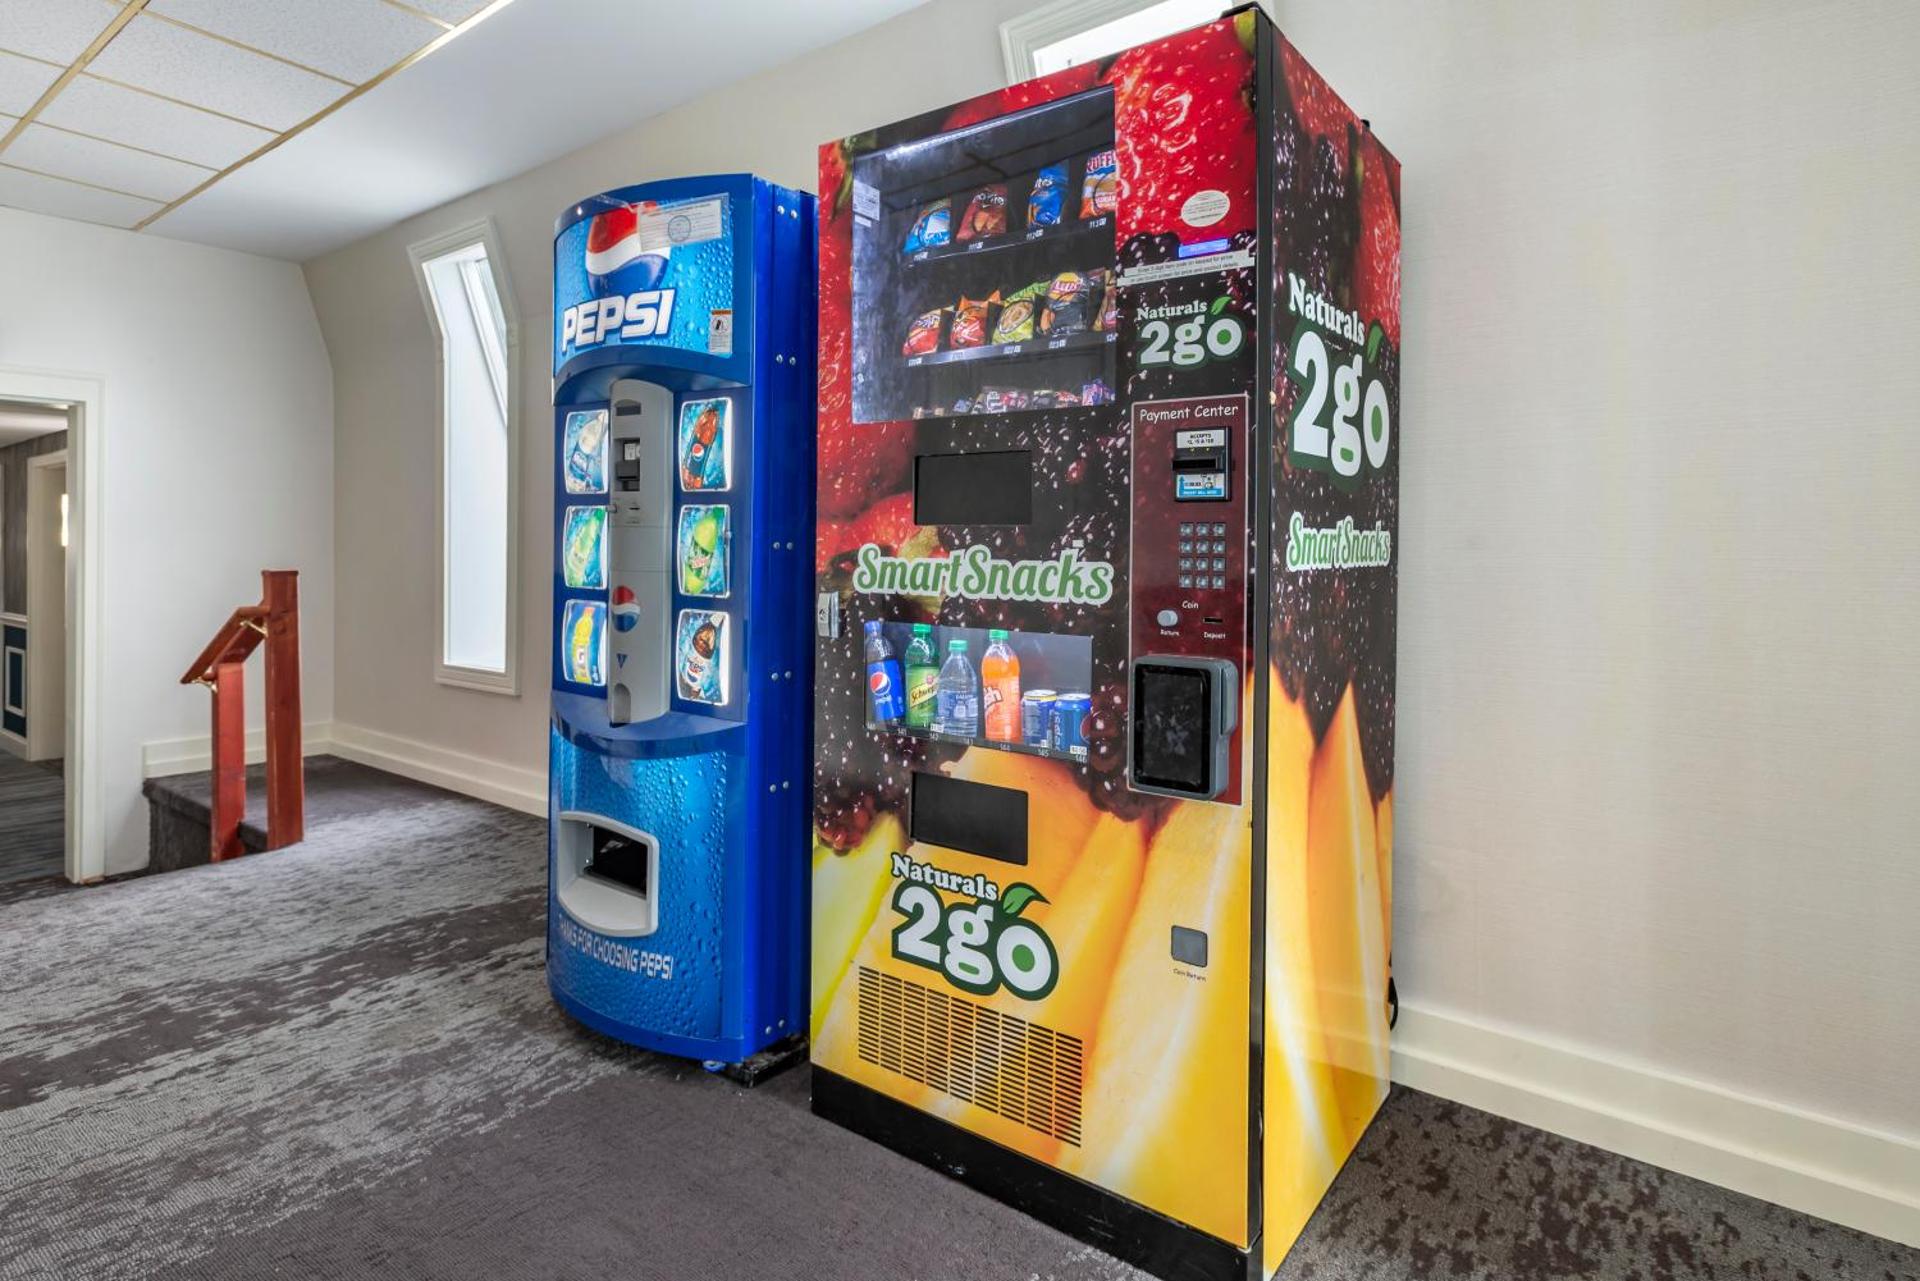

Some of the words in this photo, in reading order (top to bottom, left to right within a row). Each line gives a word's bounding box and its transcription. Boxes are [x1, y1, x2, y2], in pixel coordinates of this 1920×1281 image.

[562, 289, 676, 352] PEPSI
[1136, 300, 1208, 321] Naturals
[1288, 272, 1365, 346] Naturals
[1140, 314, 1243, 366] 2go
[1139, 408, 1191, 425] Payment
[1194, 404, 1239, 417] Center
[1294, 331, 1390, 477] 2go
[1287, 512, 1390, 570] SmartSnacks
[854, 544, 1113, 603] SmartSnacks
[1182, 600, 1199, 609] Coin
[892, 853, 998, 901] Naturals
[593, 937, 638, 973] CHOOSING
[639, 951, 674, 981] PEPSI
[898, 885, 1052, 992] 2go
